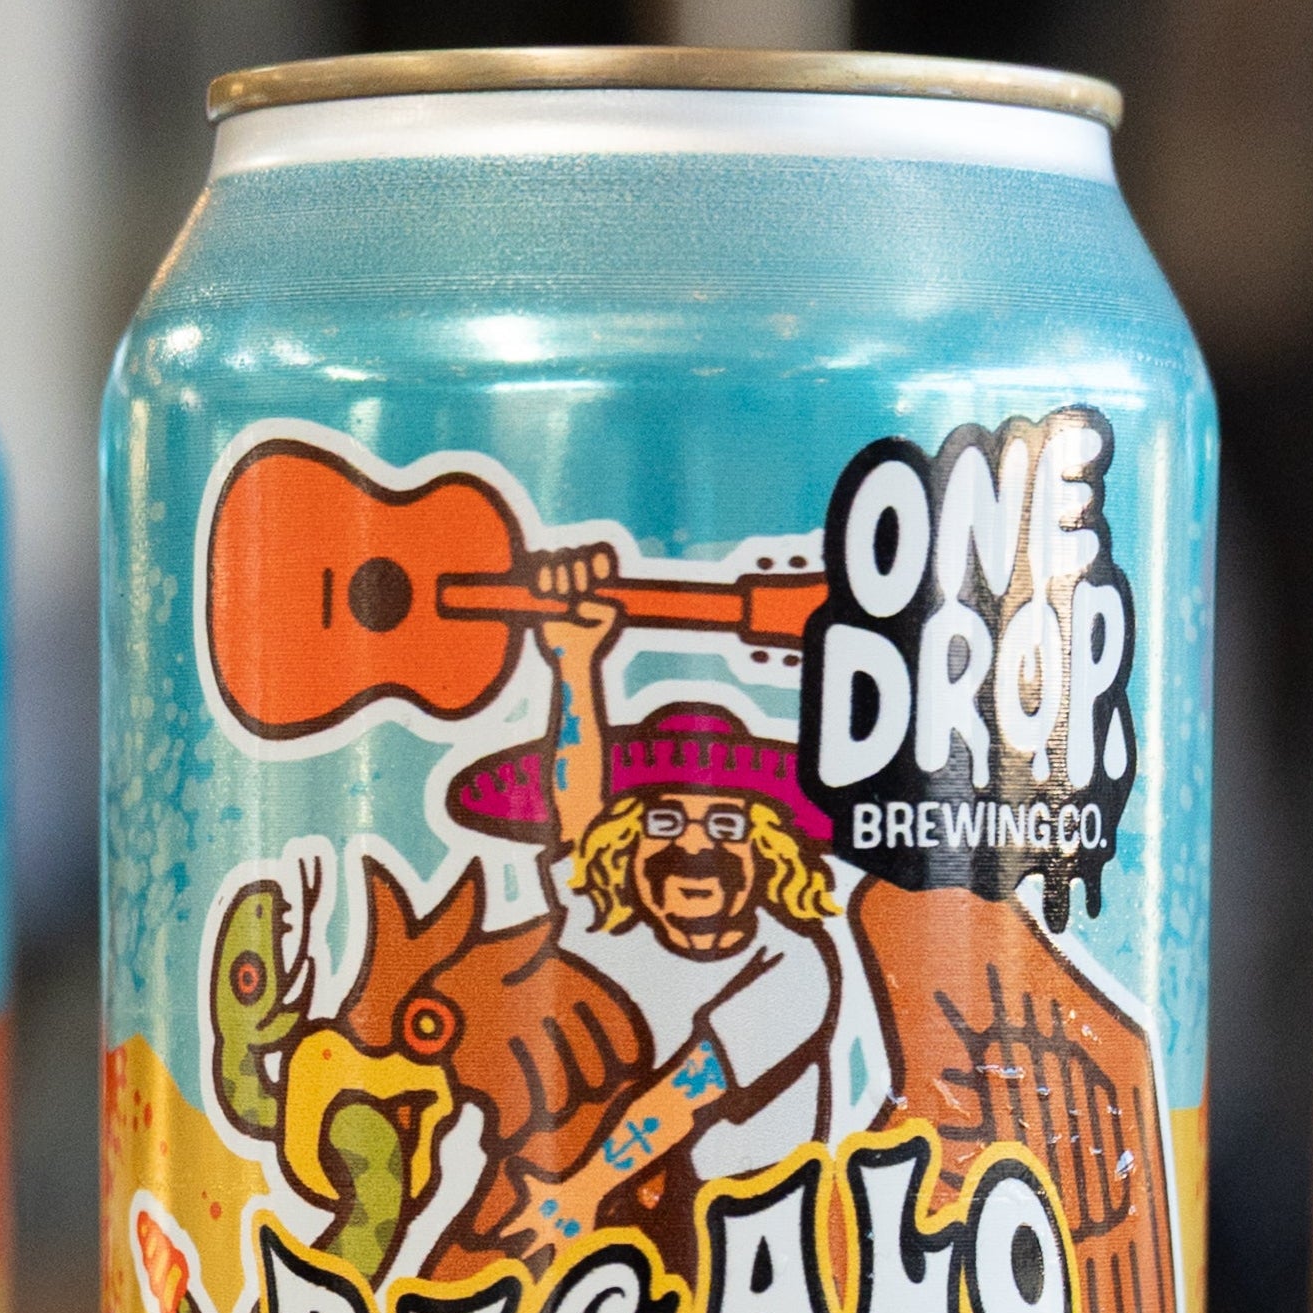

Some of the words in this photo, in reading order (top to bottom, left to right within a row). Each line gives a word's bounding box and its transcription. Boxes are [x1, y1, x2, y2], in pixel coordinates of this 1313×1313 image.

[844, 426, 1104, 618] ONE
[817, 578, 1128, 788] DROP.
[852, 800, 1050, 850] BREWING
[1057, 802, 1109, 852] CO.
